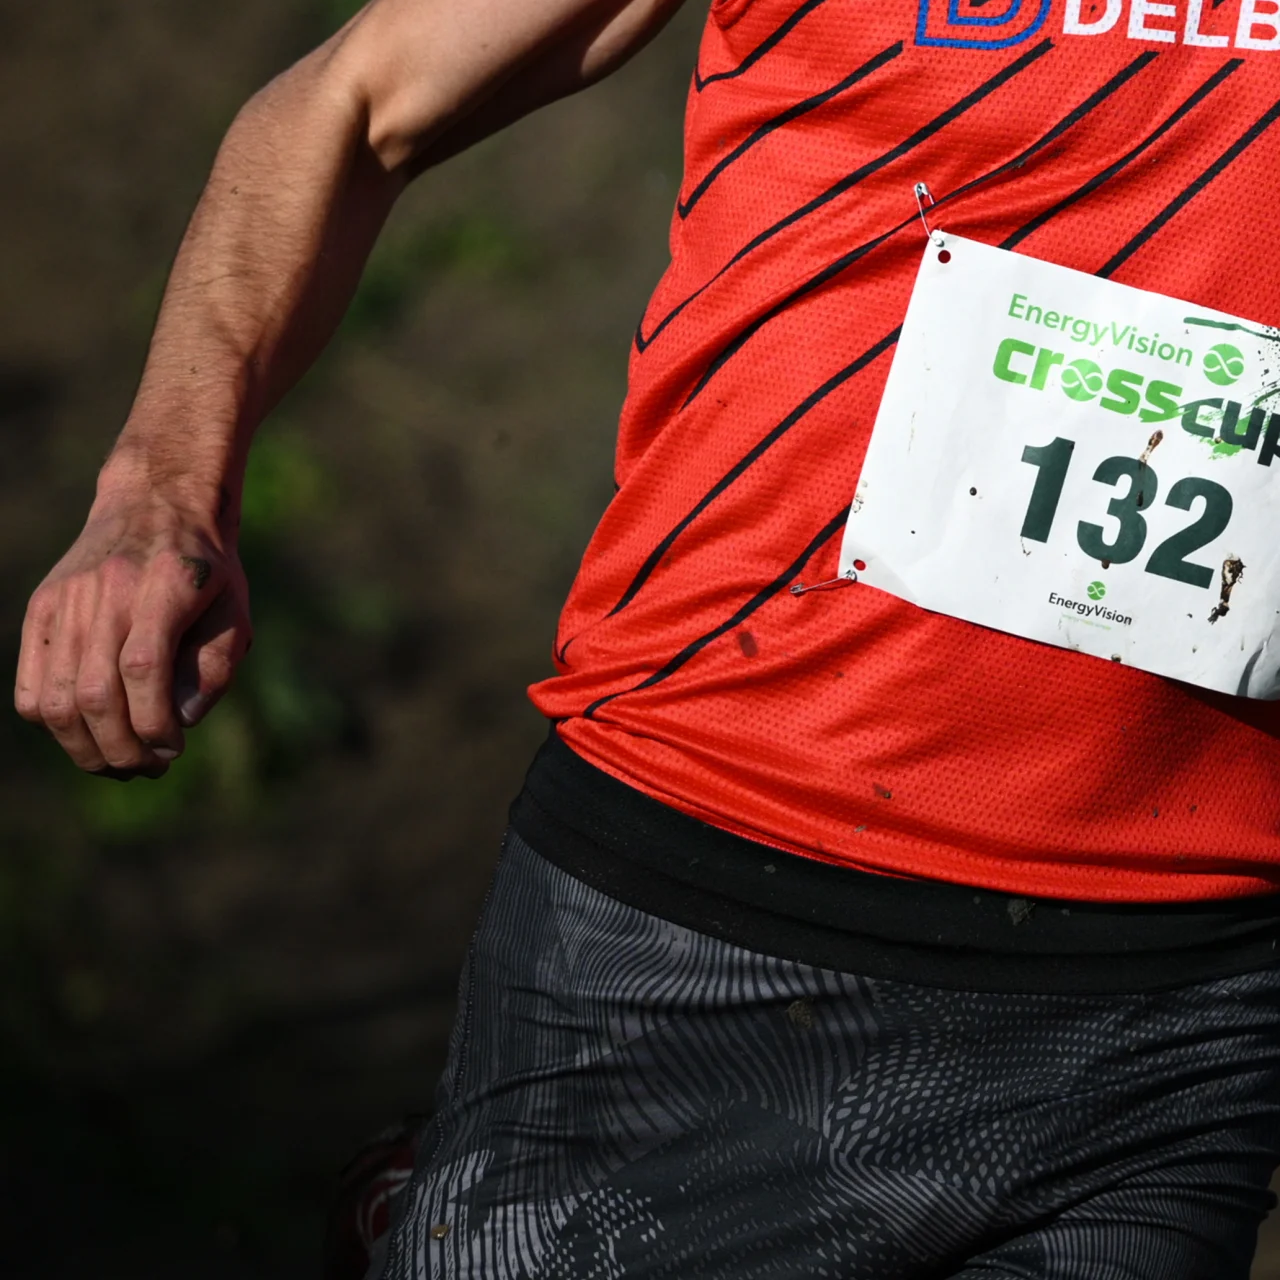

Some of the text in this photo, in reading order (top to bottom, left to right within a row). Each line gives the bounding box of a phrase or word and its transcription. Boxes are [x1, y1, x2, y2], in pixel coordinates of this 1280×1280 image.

[1007, 293, 1194, 368] EnergyVision
[1019, 435, 1235, 590] 132
[1048, 591, 1133, 626] EnergyVision
